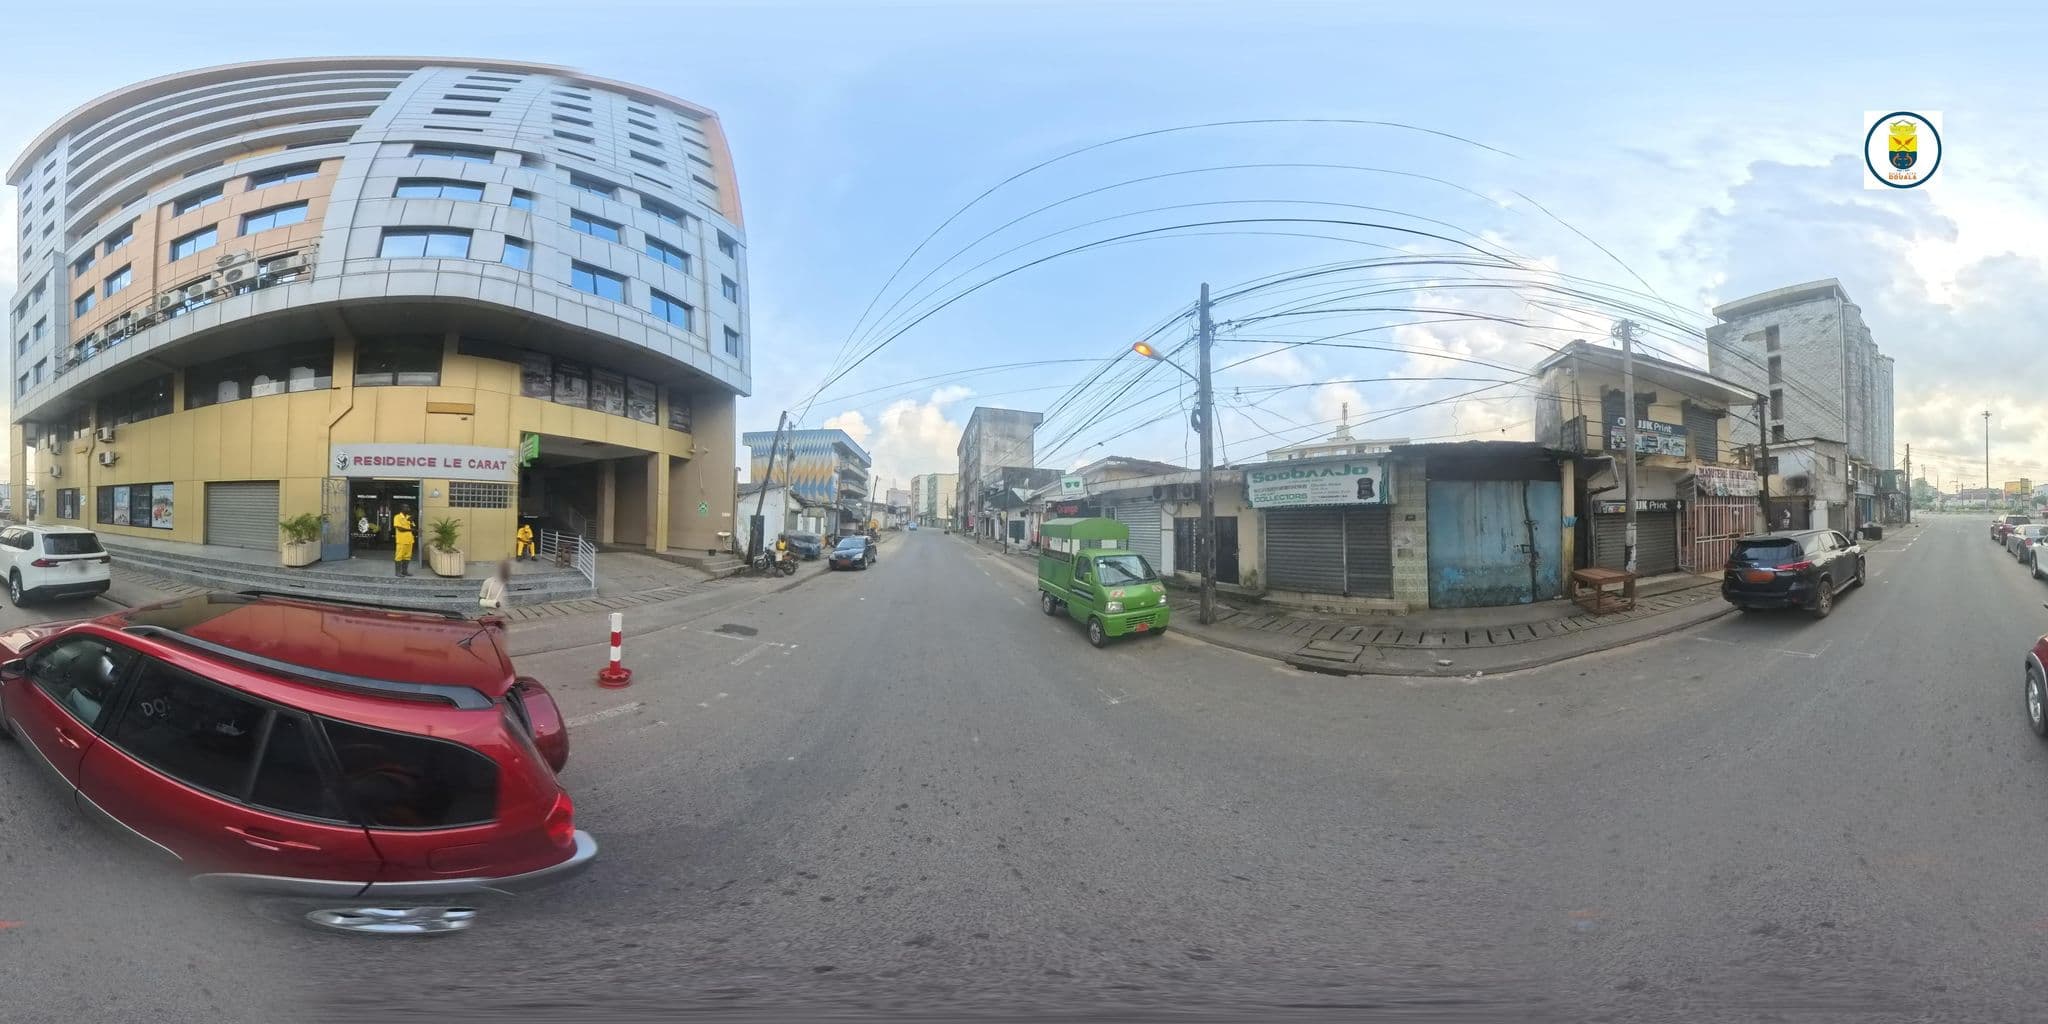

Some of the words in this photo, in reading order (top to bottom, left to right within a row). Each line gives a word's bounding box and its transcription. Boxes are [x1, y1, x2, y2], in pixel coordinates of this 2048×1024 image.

[1653, 422, 1672, 433] Print
[353, 456, 437, 468] RESIDENCE
[443, 458, 462, 468] LE
[468, 459, 507, 470] CARAT
[1254, 493, 1308, 503] COLLECTORS
[1649, 501, 1667, 510] Print
